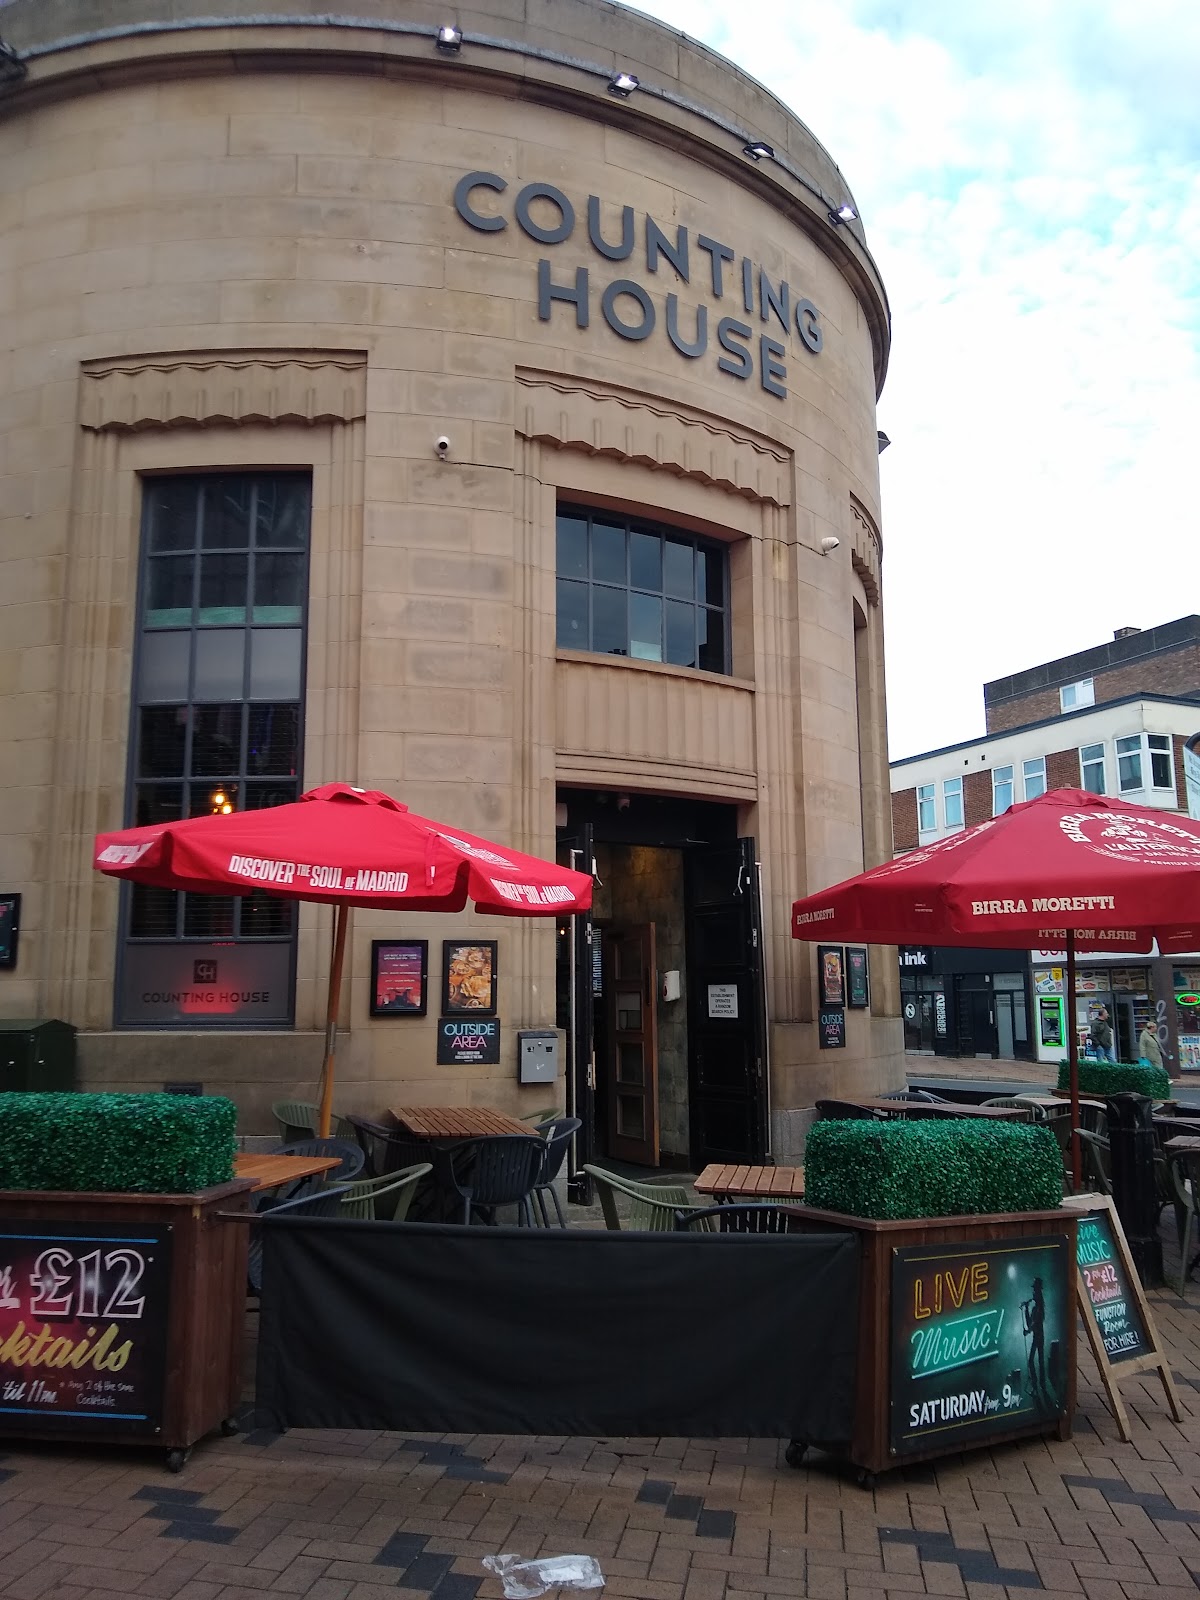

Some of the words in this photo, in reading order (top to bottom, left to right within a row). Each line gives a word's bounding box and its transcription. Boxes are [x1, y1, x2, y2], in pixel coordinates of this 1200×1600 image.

[453, 171, 823, 354] COUNTING
[538, 258, 788, 400] HOUSE
[1060, 813, 1096, 843] BIRRA
[228, 855, 295, 884] DISCOVER
[297, 863, 311, 877] THE
[310, 865, 342, 889] SOUL
[344, 876, 356, 890] OF
[355, 869, 409, 893] MADRID
[542, 885, 577, 903] MADRID
[971, 899, 1028, 915] BIRRA
[1031, 895, 1115, 913] MORETTI
[796, 912, 814, 925] BIRRA
[813, 907, 835, 921] MORETTI
[904, 951, 928, 966] ink
[142, 992, 215, 1004] COUNTING
[220, 991, 271, 1003] HOUSE
[821, 1013, 844, 1025] OUTSIDE
[444, 1023, 496, 1036] OUTSIDE
[825, 1024, 841, 1035] AREA
[451, 1035, 488, 1048] AREA
[1077, 1225, 1100, 1242] ive
[1077, 1239, 1111, 1265] MUSIC
[1083, 1270, 1094, 1288] 2
[1100, 1264, 1118, 1284] £12
[915, 1262, 989, 1319] LIVE
[1090, 1282, 1123, 1303] Cocktails
[1095, 1302, 1127, 1322] FUNCTION
[910, 1308, 1005, 1369] Music!
[1103, 1336, 1120, 1352] FOR
[1117, 1330, 1140, 1348] HIRE!
[909, 1390, 986, 1427] SATURDAY
